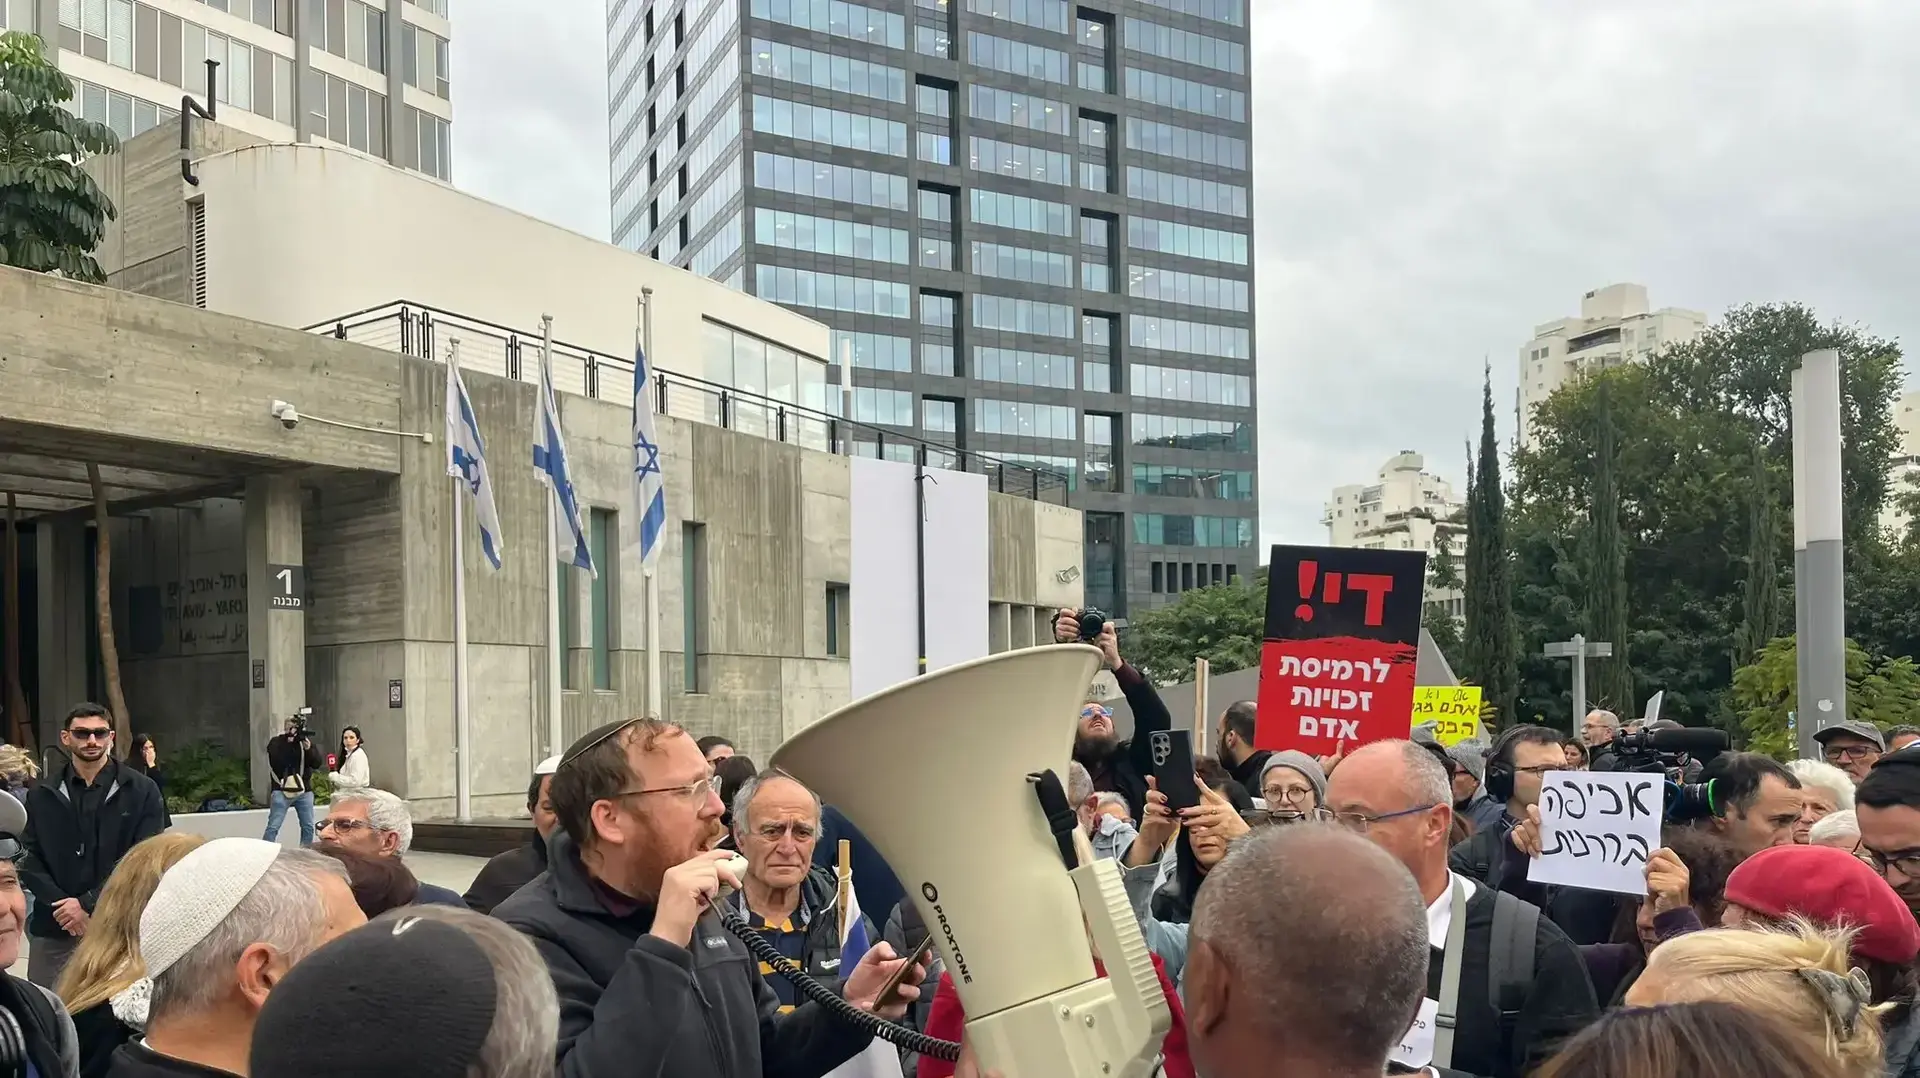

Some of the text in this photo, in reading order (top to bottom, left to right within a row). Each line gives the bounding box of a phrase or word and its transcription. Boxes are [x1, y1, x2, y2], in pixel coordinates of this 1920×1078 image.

[276, 568, 293, 595] 1
[1295, 560, 1394, 626] די!
[273, 596, 301, 607] מבנה
[1279, 656, 1391, 683] לרמיסת
[1291, 686, 1373, 712] זכויות
[1413, 702, 1477, 716] אתם מג
[1300, 716, 1360, 740] אדם
[1542, 780, 1652, 820] אכיפה
[1541, 829, 1649, 866] בררנית
[933, 904, 973, 984] PROXTONE
